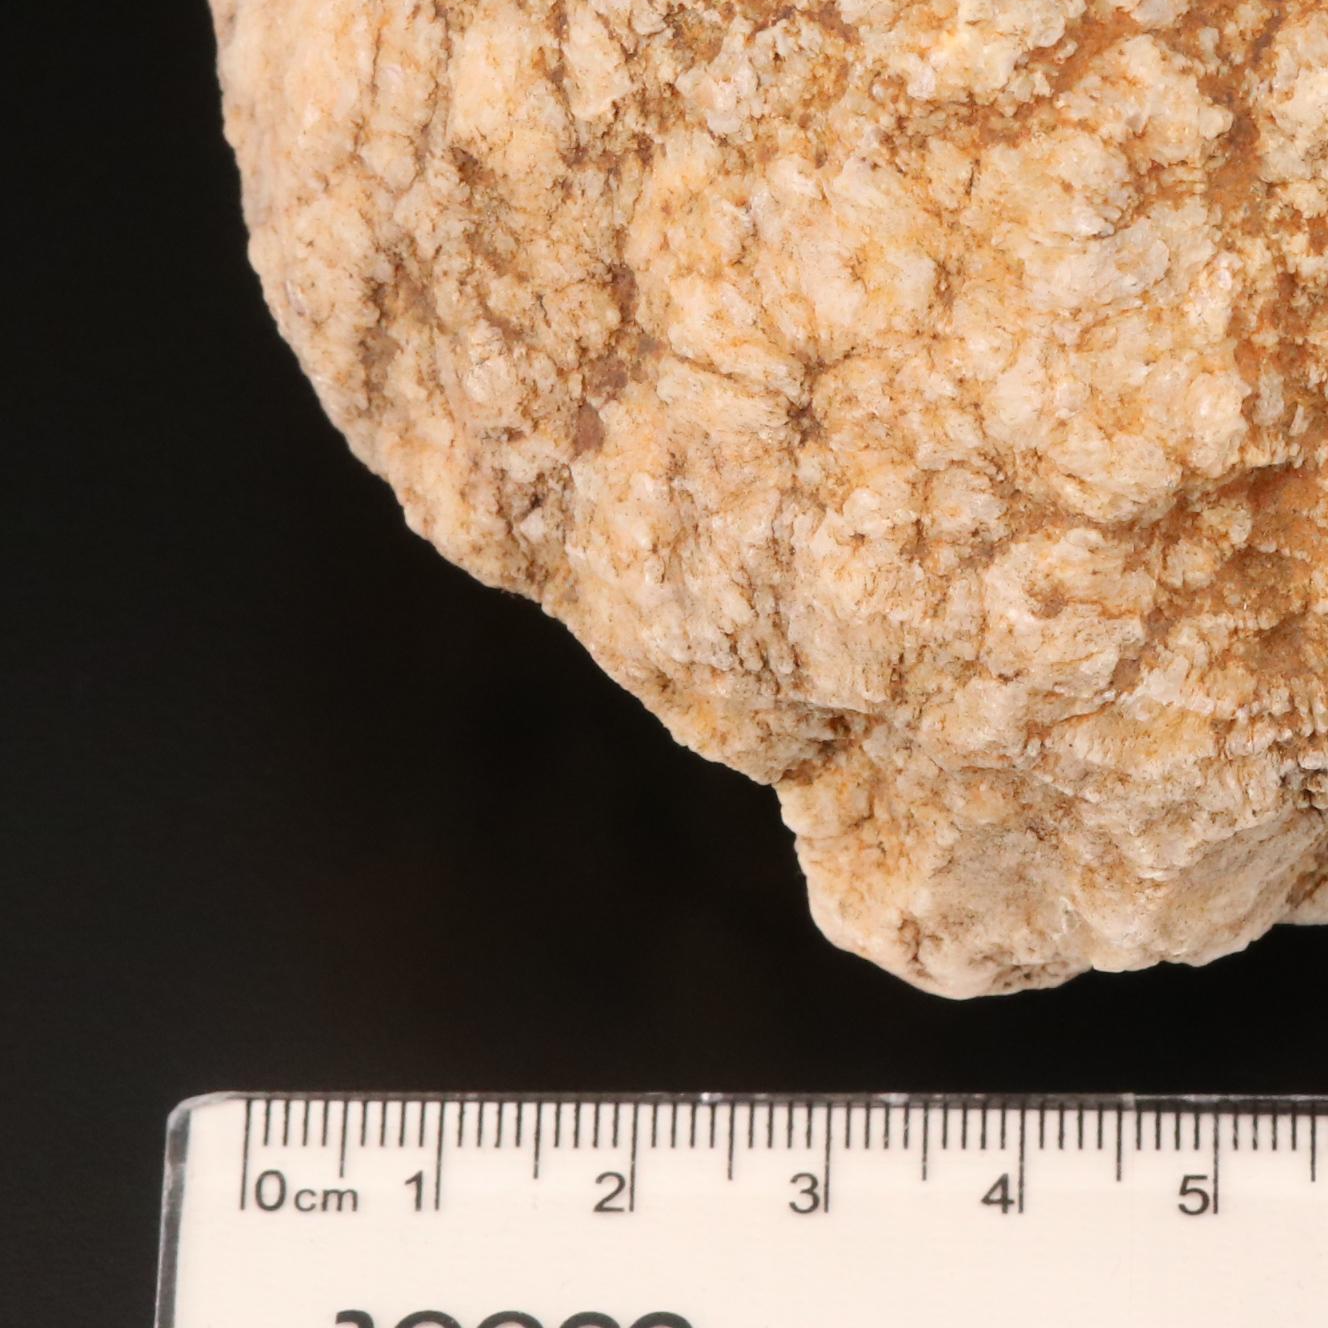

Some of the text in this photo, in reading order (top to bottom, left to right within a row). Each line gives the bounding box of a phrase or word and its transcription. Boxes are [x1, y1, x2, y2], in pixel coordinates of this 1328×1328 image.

[405, 1171, 423, 1211] 1
[594, 1171, 626, 1213] 2
[789, 1173, 821, 1215] 3
[981, 1173, 1015, 1215] 4
[1178, 1174, 1211, 1216] 5
